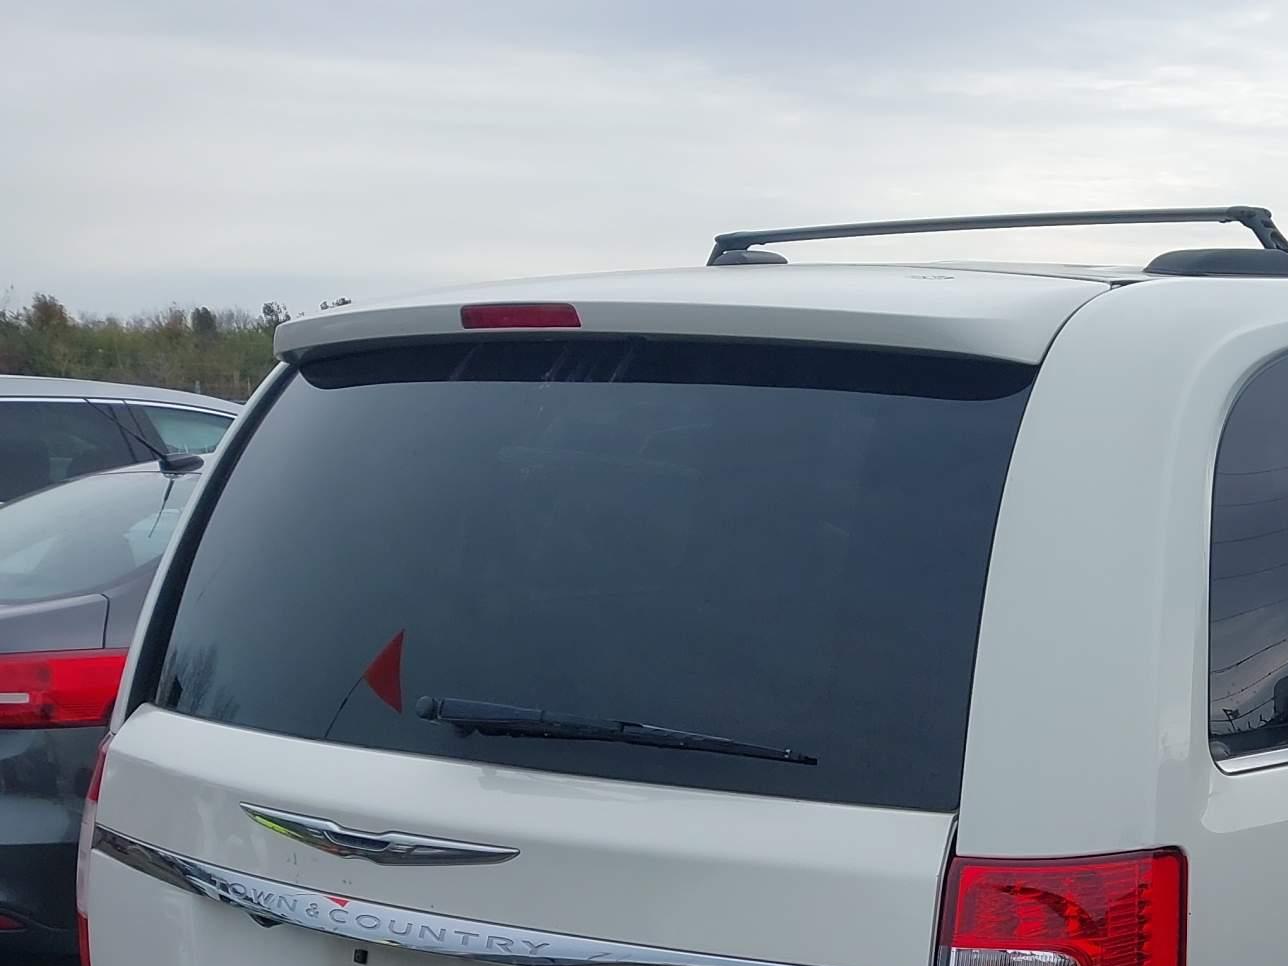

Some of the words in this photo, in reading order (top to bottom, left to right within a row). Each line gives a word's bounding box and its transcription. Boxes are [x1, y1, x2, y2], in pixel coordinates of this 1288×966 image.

[210, 876, 297, 912] TOWN
[304, 902, 320, 919] &
[328, 908, 550, 955] COUNTRY
